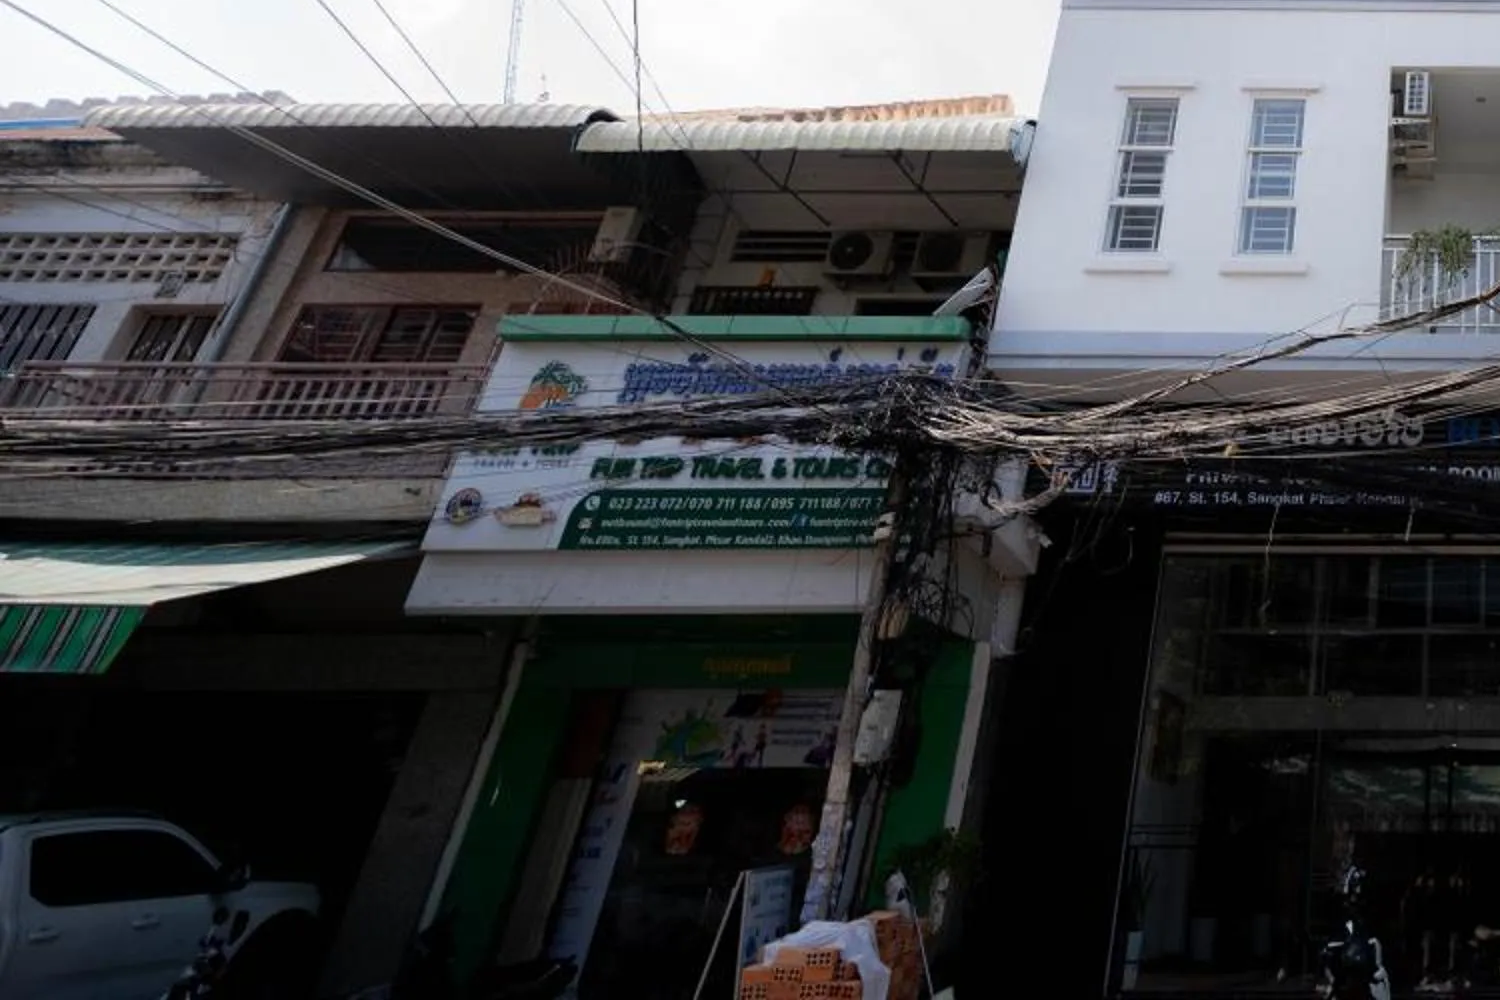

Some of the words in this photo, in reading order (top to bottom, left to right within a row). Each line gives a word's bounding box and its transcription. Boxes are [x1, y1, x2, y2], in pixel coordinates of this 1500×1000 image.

[590, 457, 636, 478] FUN
[640, 457, 685, 478] TRIP
[691, 457, 765, 478] TRAVEL
[772, 457, 787, 478] &
[794, 457, 859, 478] TOURS
[1154, 490, 1182, 506] #67,
[1212, 490, 1242, 506] 154,
[1247, 490, 1304, 508] Sangkat
